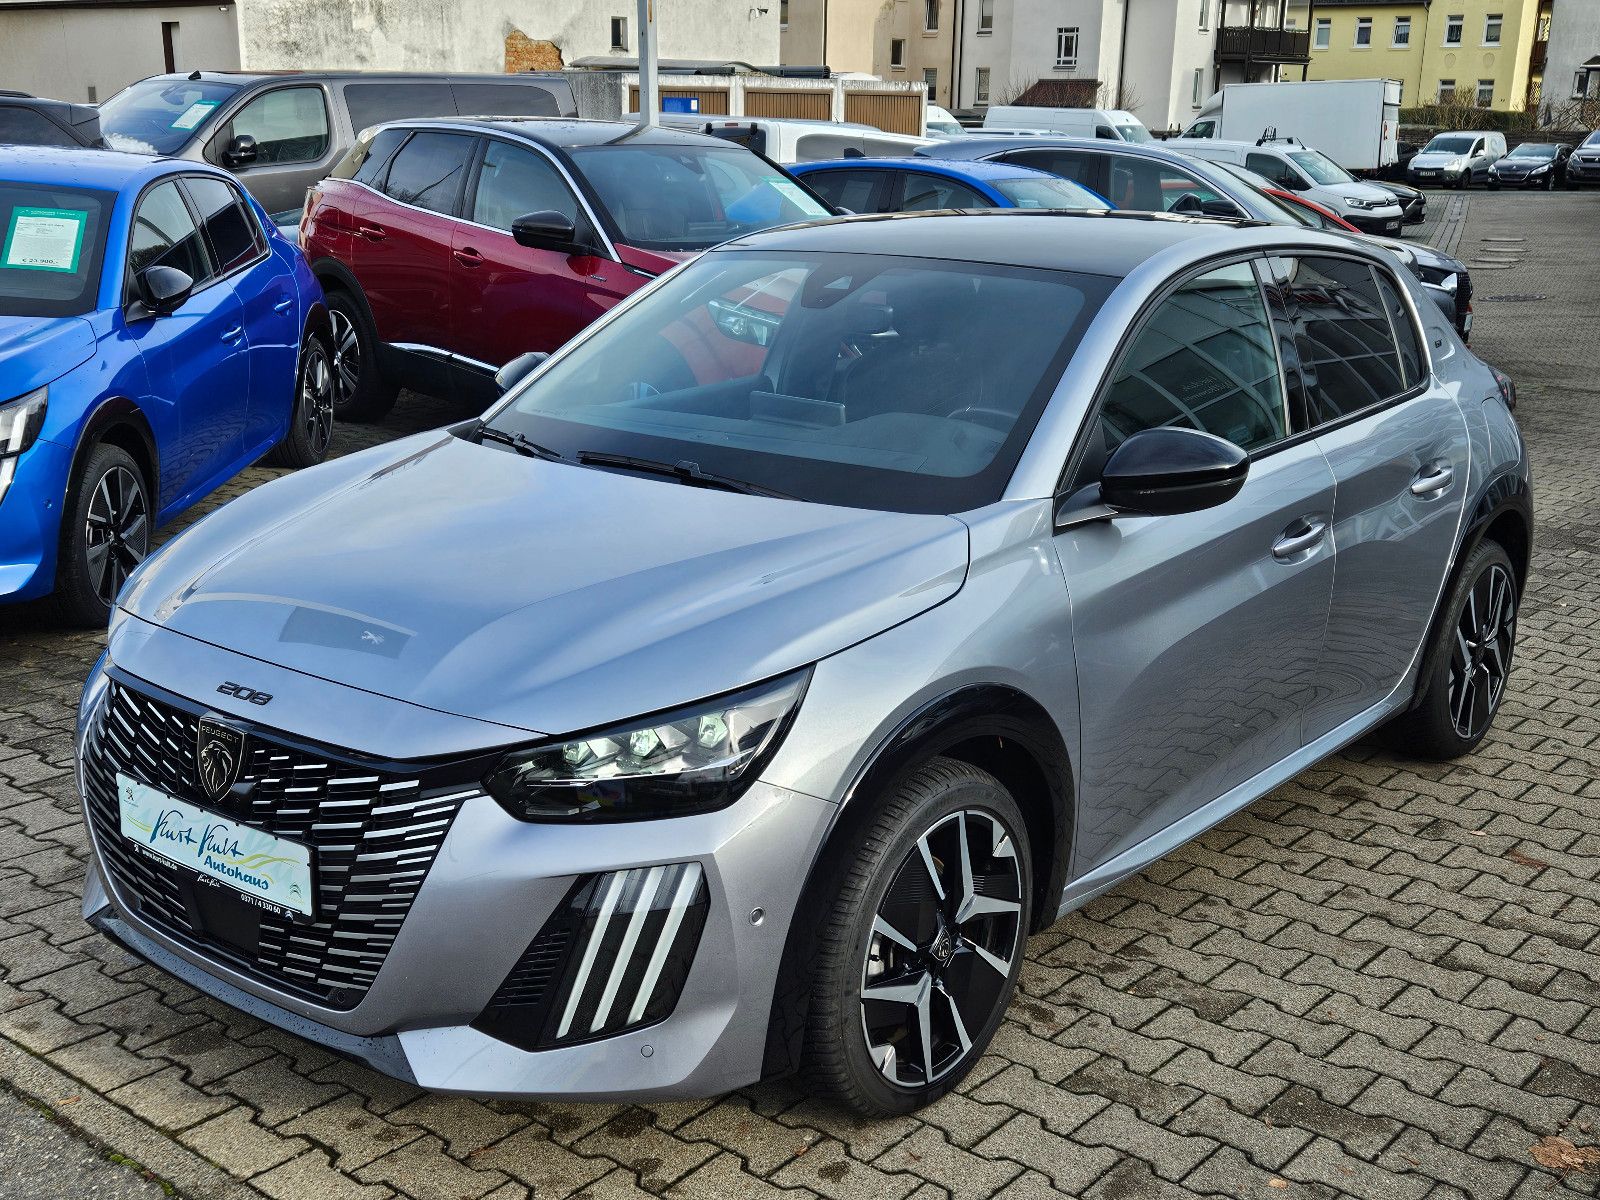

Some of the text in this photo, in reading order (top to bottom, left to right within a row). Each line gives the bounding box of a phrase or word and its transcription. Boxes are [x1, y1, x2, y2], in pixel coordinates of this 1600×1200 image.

[216, 681, 273, 705] 208
[201, 725, 239, 744] PEUGEOT
[150, 809, 244, 857] Kurt Kult
[204, 855, 269, 890] Autohaus
